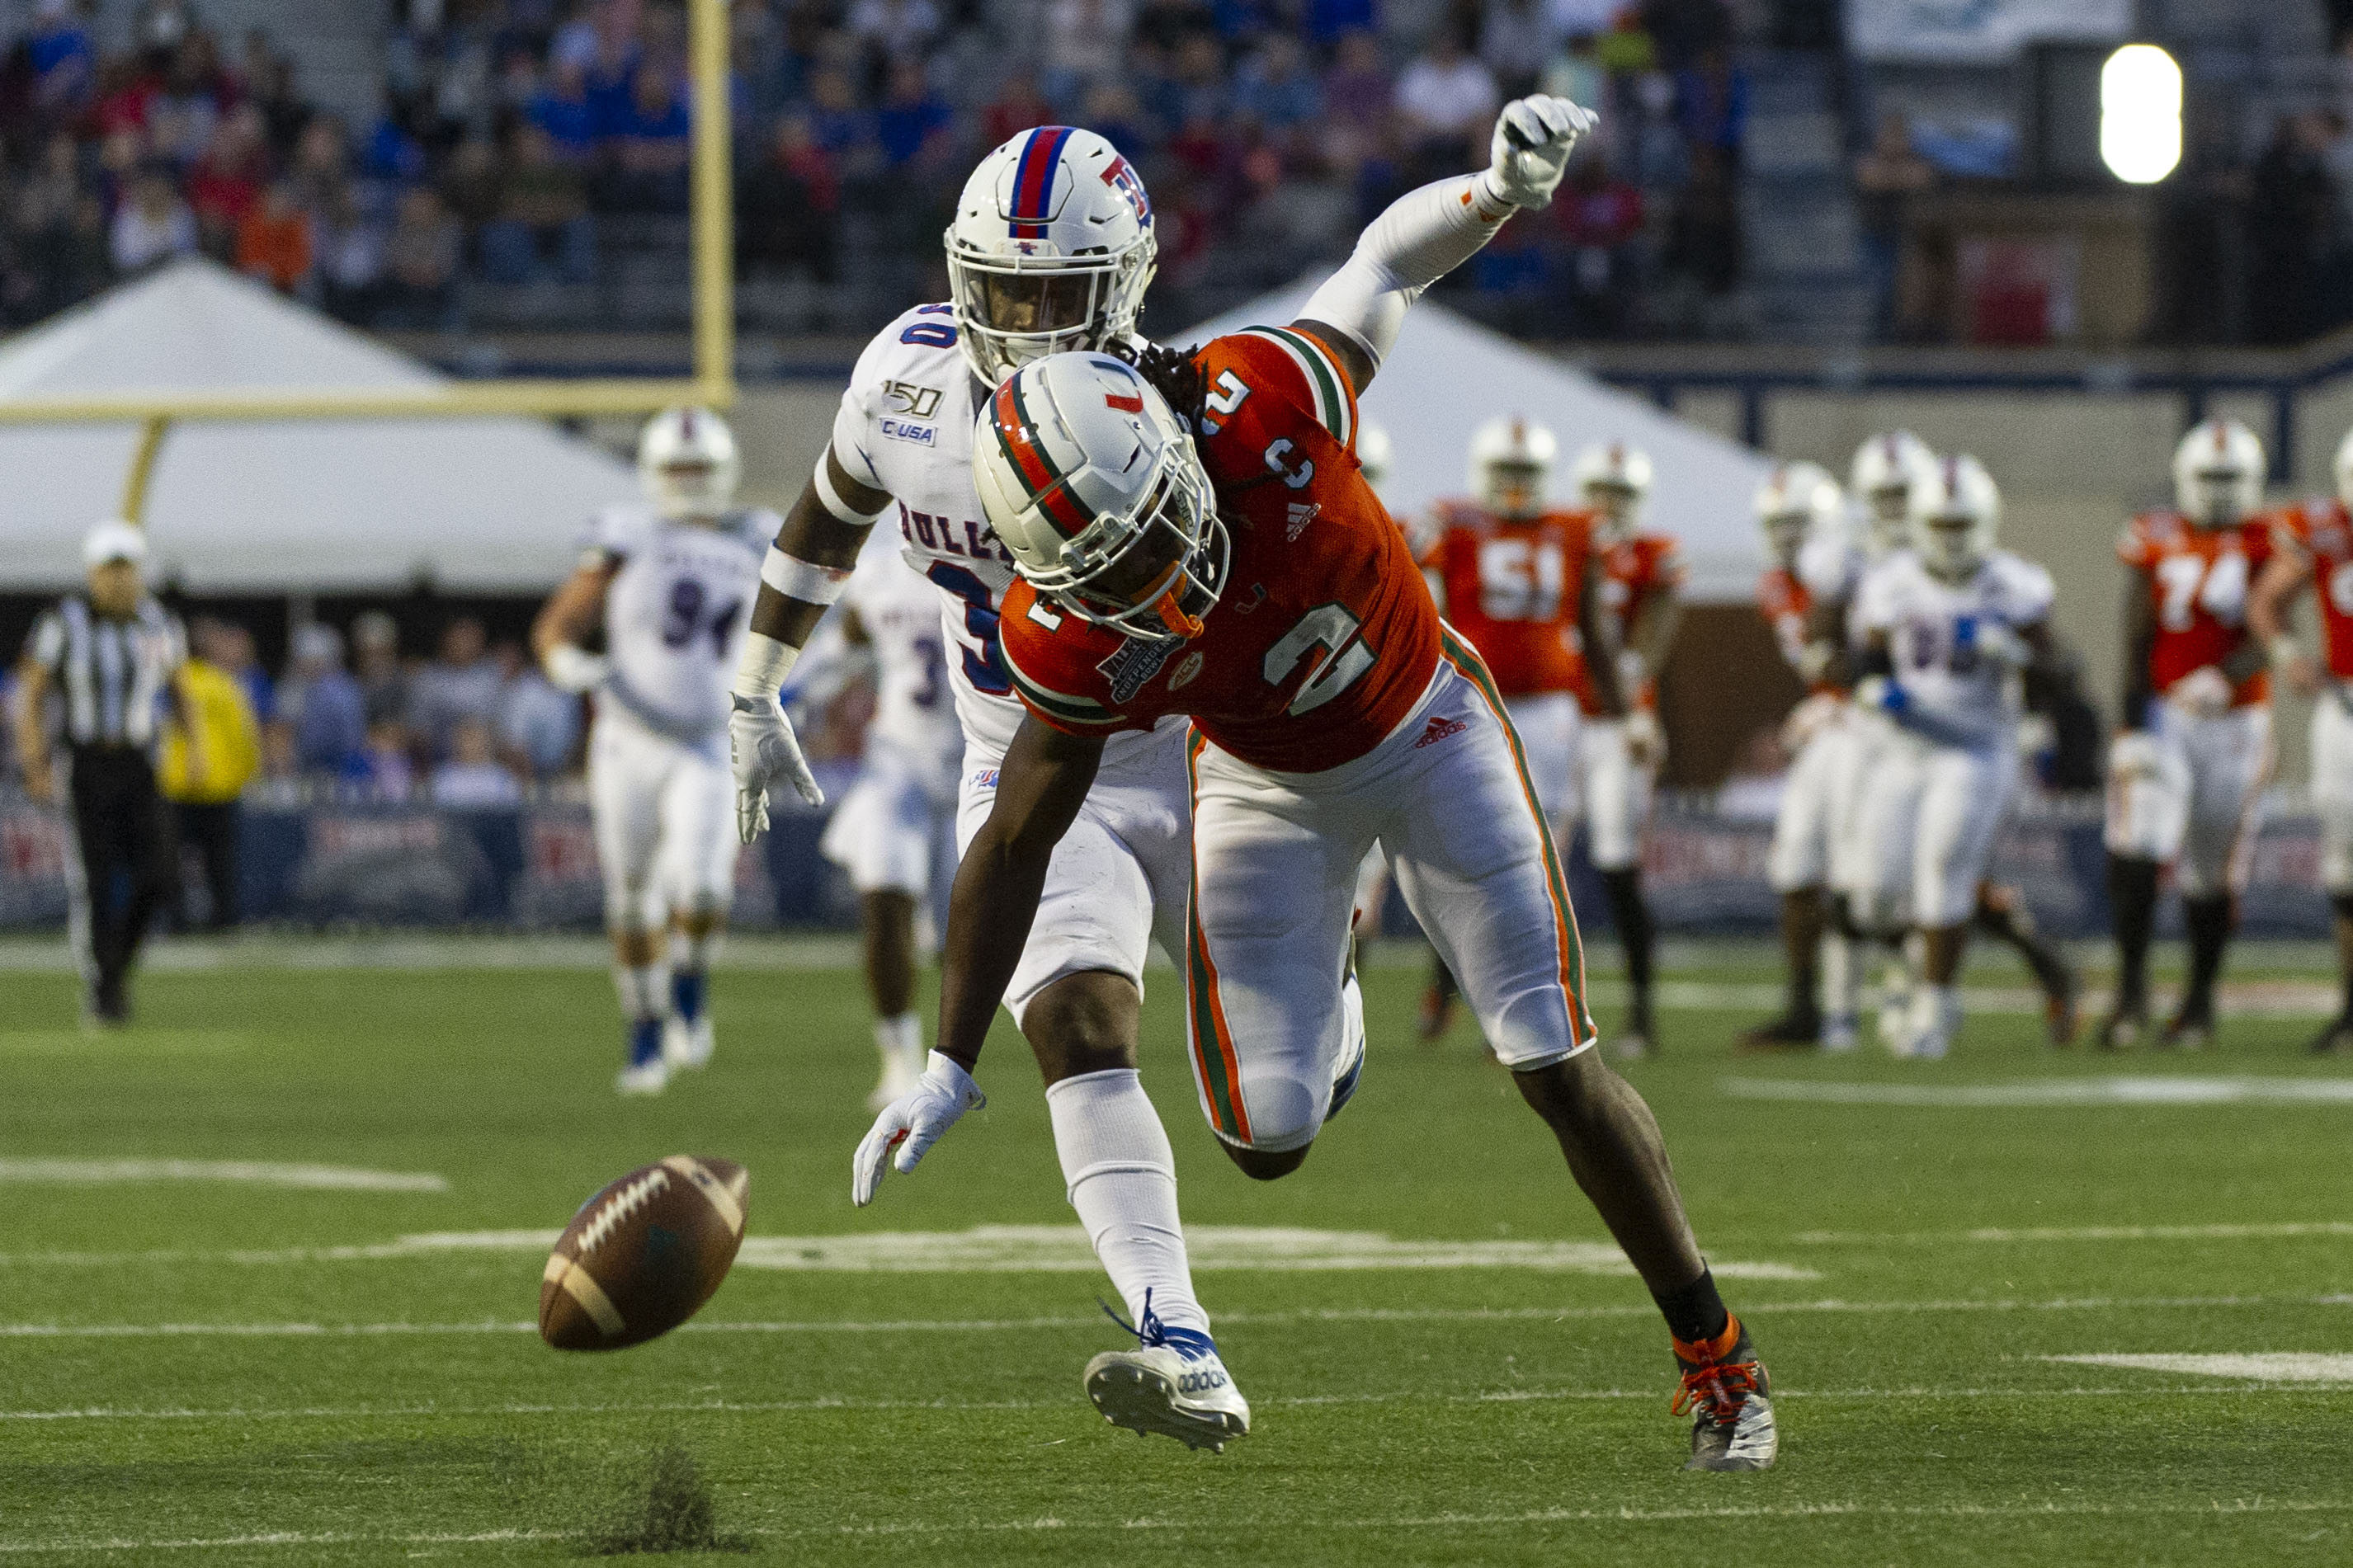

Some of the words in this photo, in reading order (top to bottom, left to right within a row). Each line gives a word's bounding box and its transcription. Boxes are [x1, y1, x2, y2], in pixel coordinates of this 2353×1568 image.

[1262, 436, 1316, 489] C
[1287, 502, 1322, 543] adidas
[1478, 538, 1565, 622] 51
[2155, 554, 2251, 633] 74
[1261, 599, 1381, 718] 2
[1415, 720, 1467, 749] adidas
[1178, 1367, 1227, 1393] adidas
